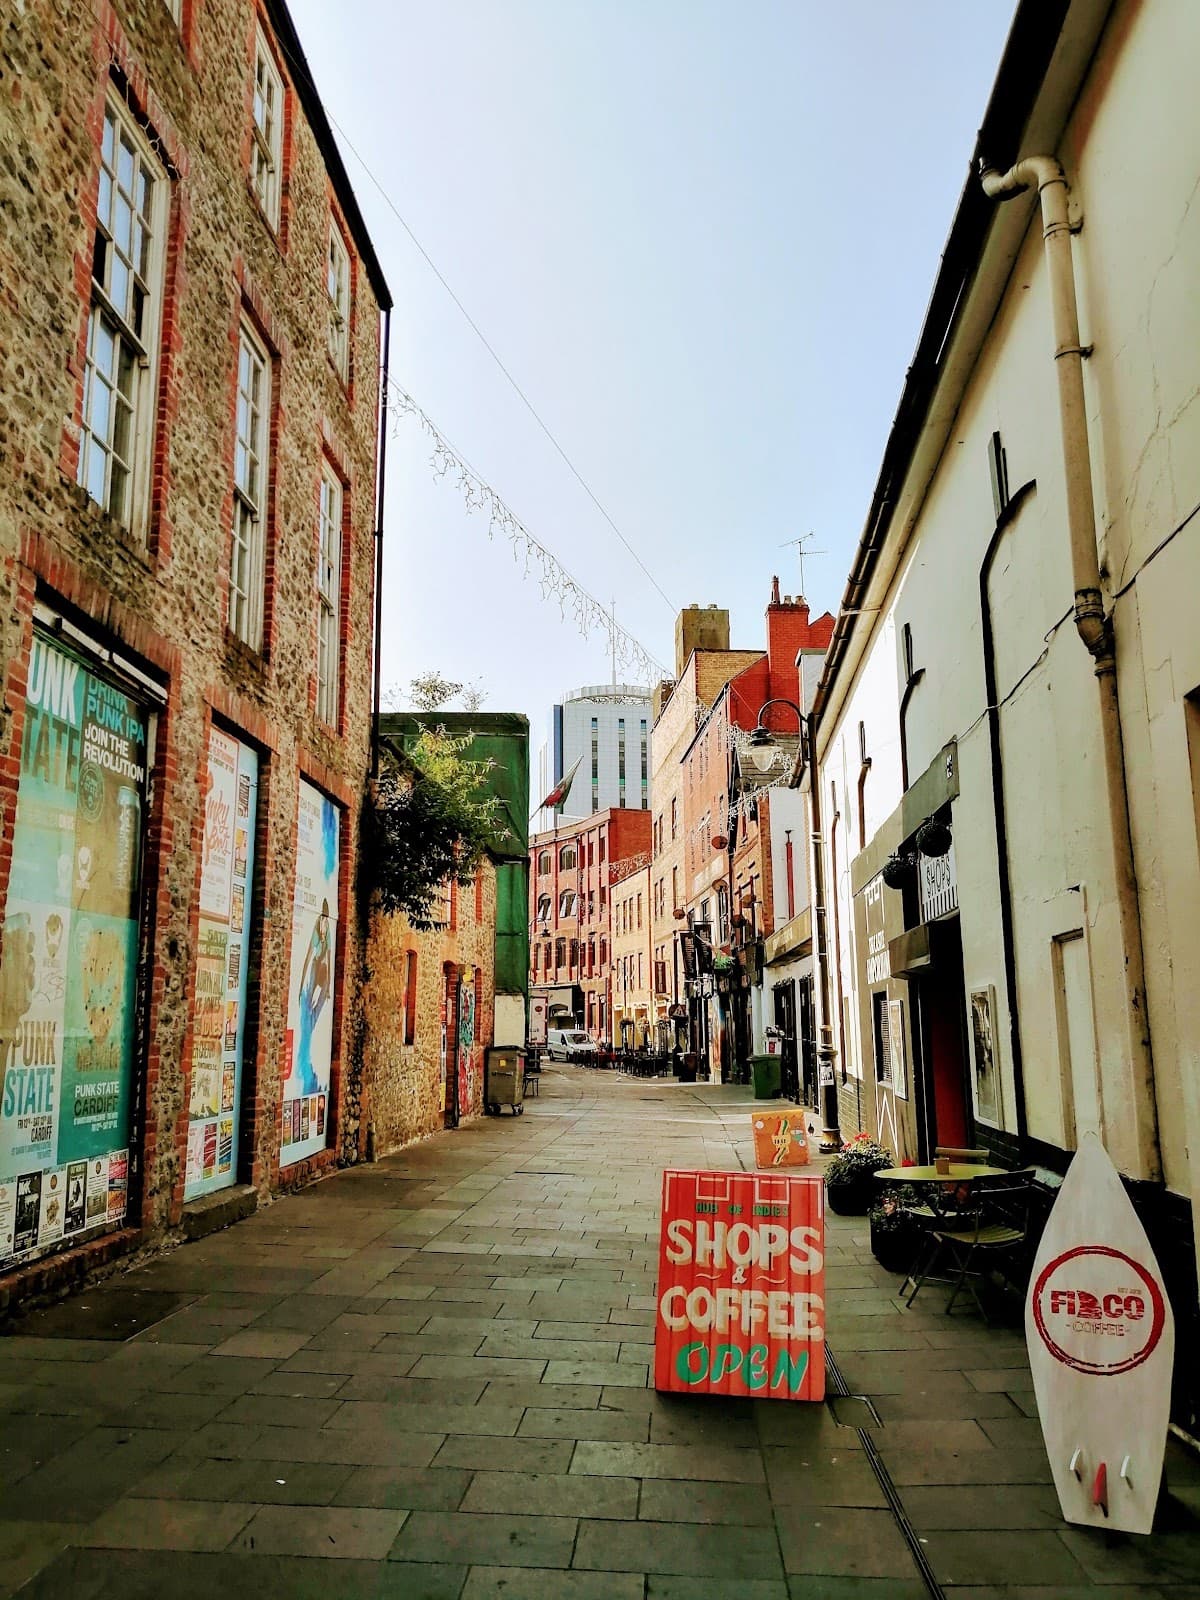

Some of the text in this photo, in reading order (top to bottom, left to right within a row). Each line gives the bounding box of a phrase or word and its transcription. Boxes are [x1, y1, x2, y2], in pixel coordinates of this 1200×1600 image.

[86, 675, 128, 714] DRINK
[84, 722, 129, 758] JOIN THE
[86, 695, 145, 747] PUNK IPA
[83, 743, 144, 783] REVOLUTION
[926, 855, 951, 899] SHOPS
[10, 1021, 56, 1067] PUNK
[4, 1067, 55, 1117] STATE
[74, 1081, 120, 1098] PUNK STATE
[74, 1096, 119, 1117] CARDIFF
[695, 1202, 789, 1217] HUB OF INDIES
[666, 1219, 823, 1275] SHOPS
[732, 1265, 747, 1285] &
[660, 1285, 824, 1342] COFFEE
[1072, 1321, 1125, 1337] COFFEE
[675, 1341, 809, 1393] OPEN
